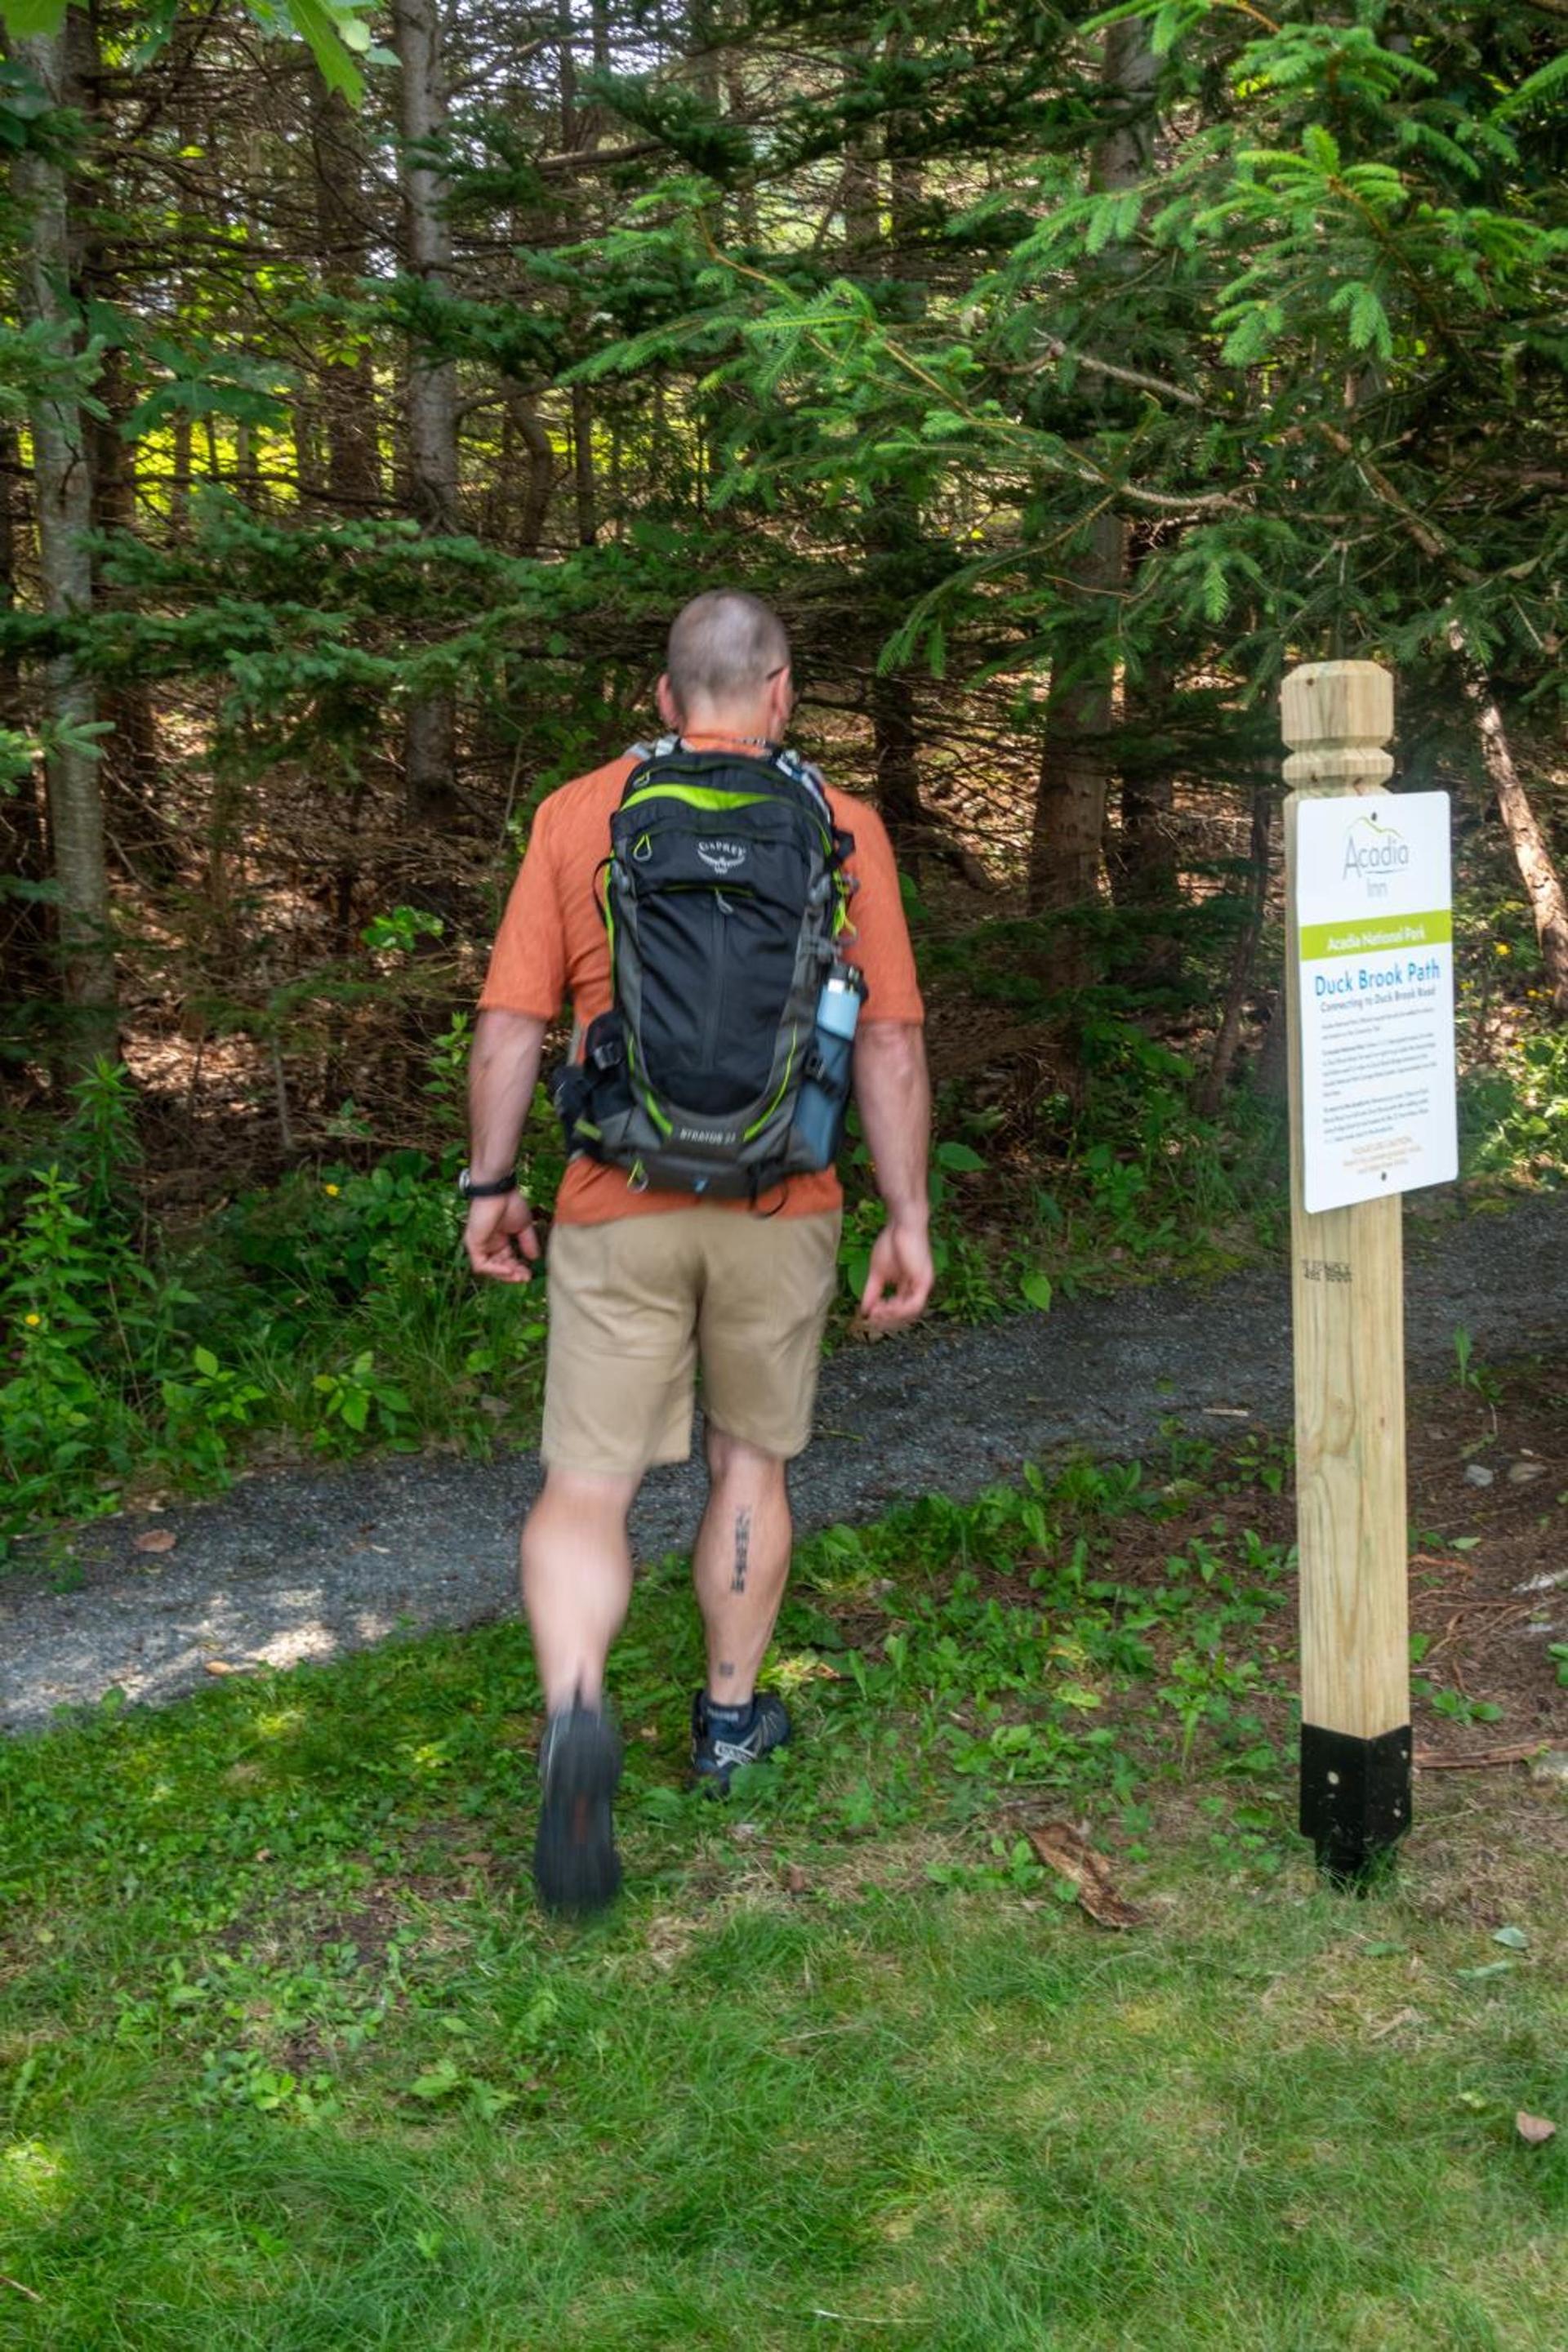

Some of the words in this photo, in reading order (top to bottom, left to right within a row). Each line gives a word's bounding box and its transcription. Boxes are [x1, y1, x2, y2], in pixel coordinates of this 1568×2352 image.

[698, 841, 746, 856] OSPREY
[1343, 835, 1409, 880] Acadia
[1315, 969, 1353, 996] Duck
[1358, 962, 1402, 990] Brook
[1408, 957, 1441, 982] Path
[1374, 992, 1392, 1004] Duck
[1395, 988, 1415, 1001] Brook
